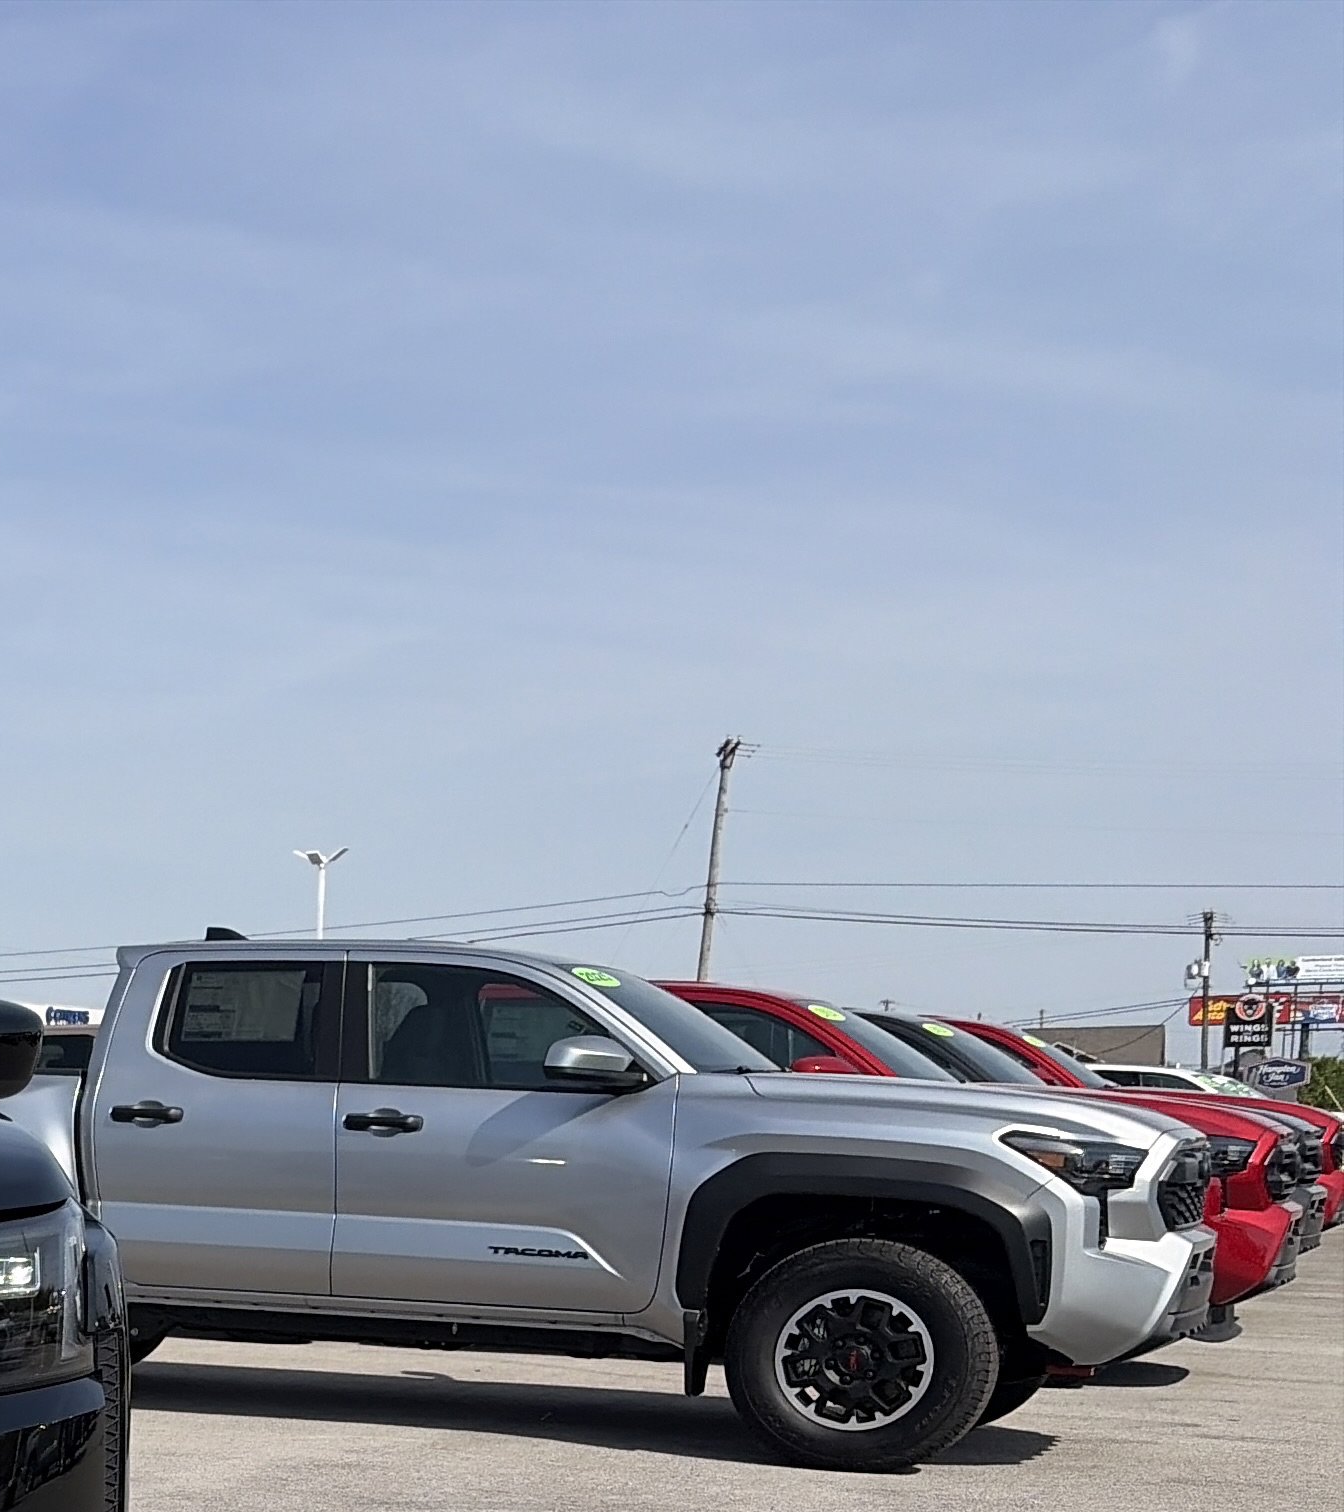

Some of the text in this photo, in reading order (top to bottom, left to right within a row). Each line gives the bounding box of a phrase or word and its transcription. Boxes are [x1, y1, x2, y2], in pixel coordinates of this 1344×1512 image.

[1229, 1023, 1269, 1032] WINGS
[1230, 1034, 1269, 1043] RINGS
[1257, 1064, 1301, 1075] Hampton
[487, 1245, 589, 1260] TACOMA
